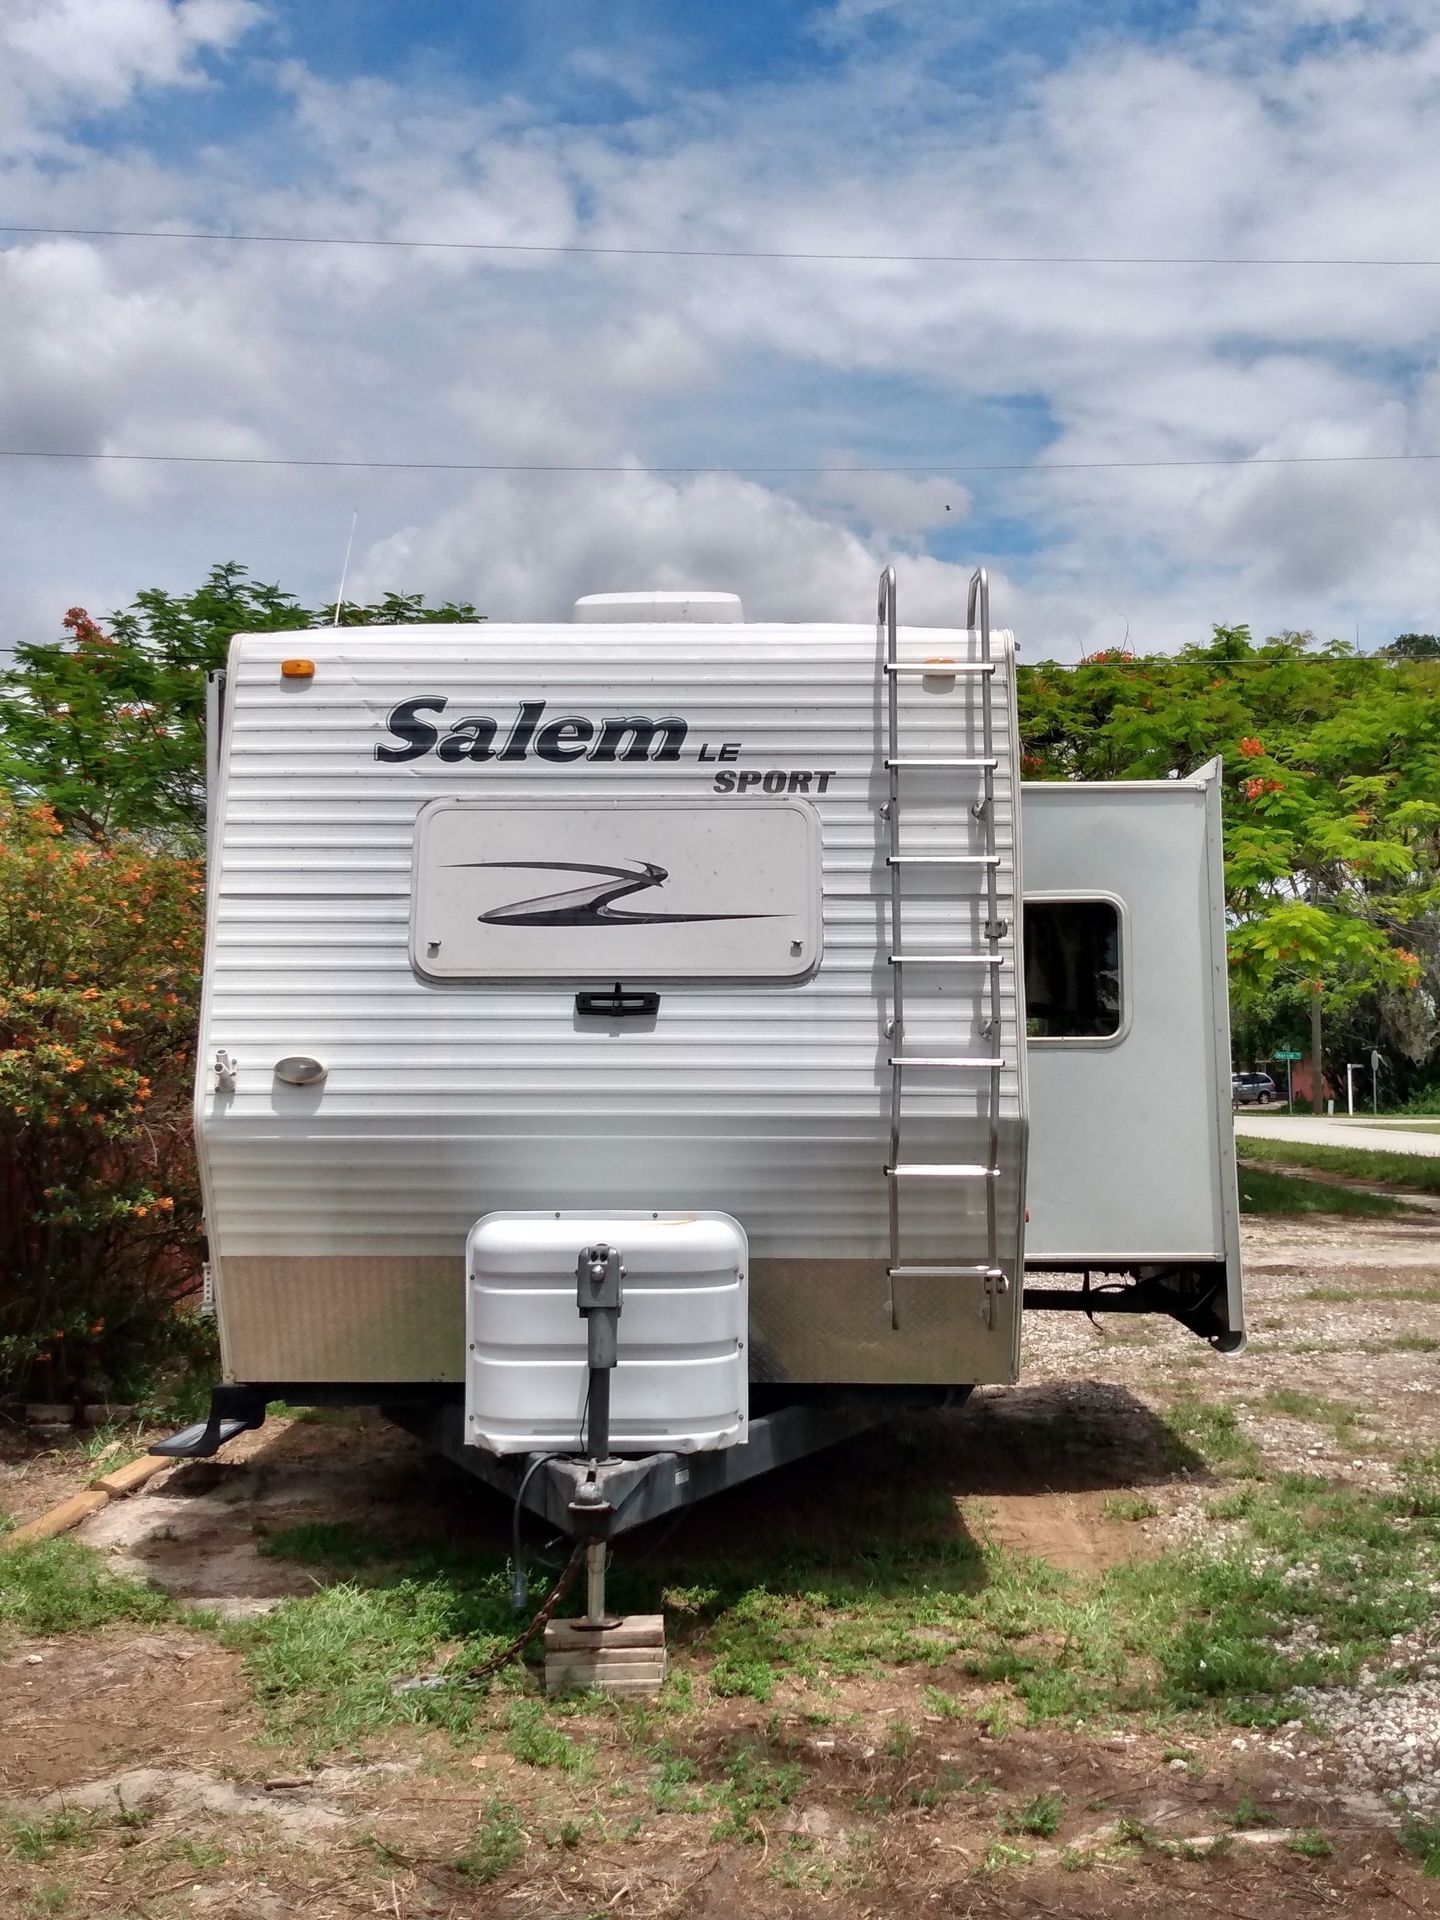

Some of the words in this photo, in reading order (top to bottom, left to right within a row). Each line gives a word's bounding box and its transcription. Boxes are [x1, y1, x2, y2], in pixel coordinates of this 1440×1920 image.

[374, 695, 688, 763] Salem
[698, 743, 742, 762] LE
[713, 770, 837, 794] SPORT
